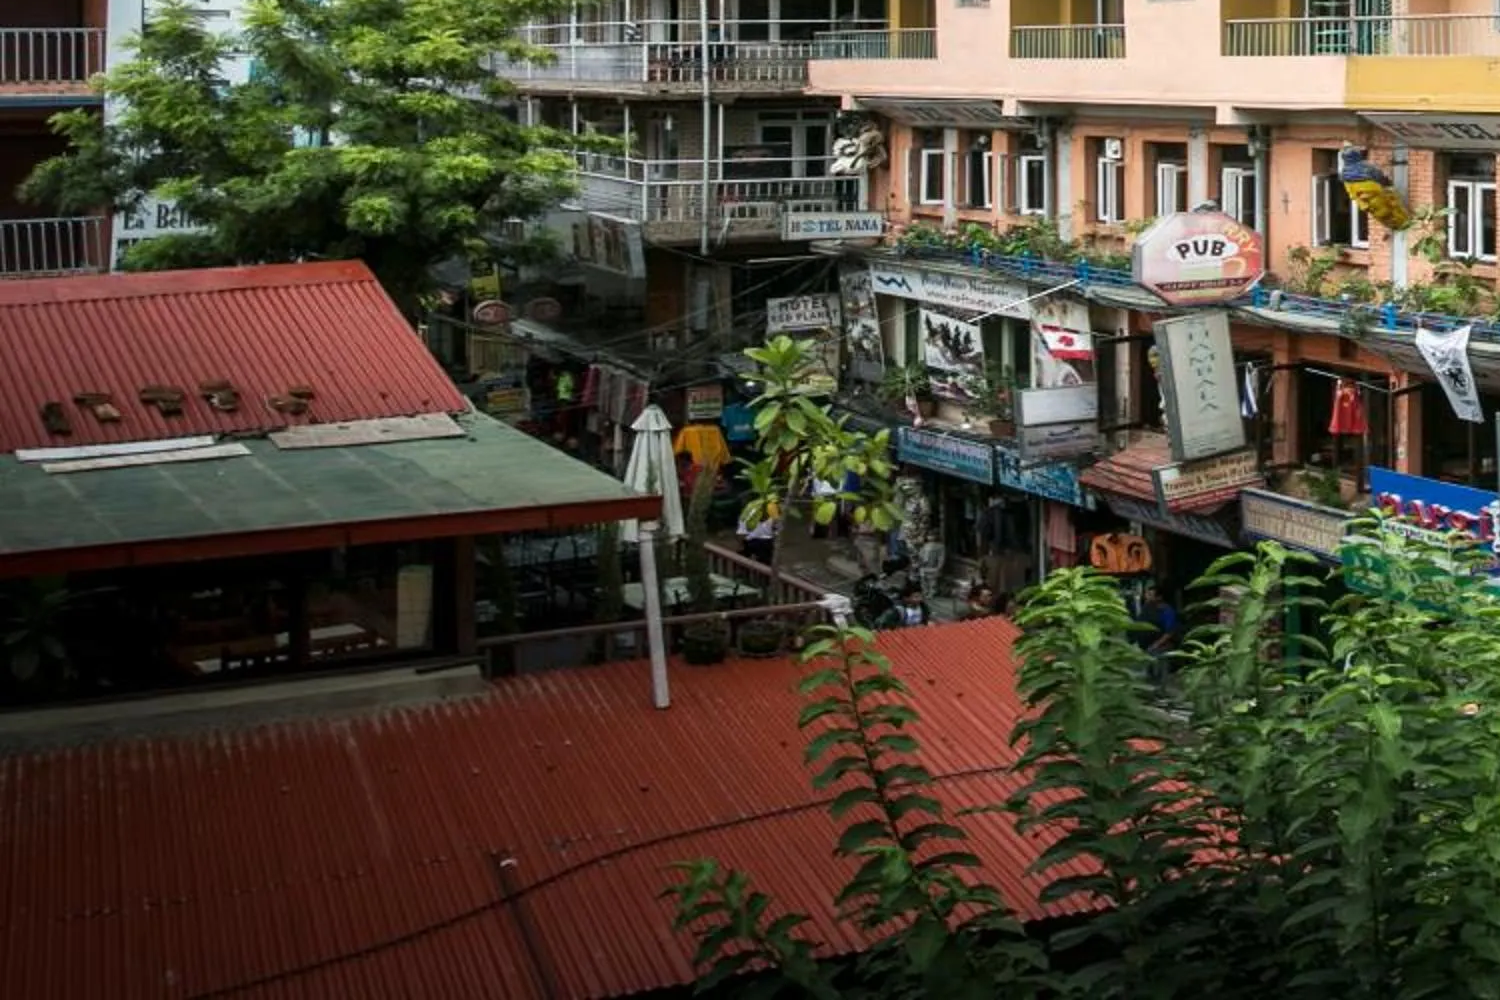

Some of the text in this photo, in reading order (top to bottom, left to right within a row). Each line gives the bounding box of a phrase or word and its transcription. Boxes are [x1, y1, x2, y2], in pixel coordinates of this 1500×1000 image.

[791, 219, 879, 233] HOTEL NANA
[1175, 239, 1227, 260] PUB
